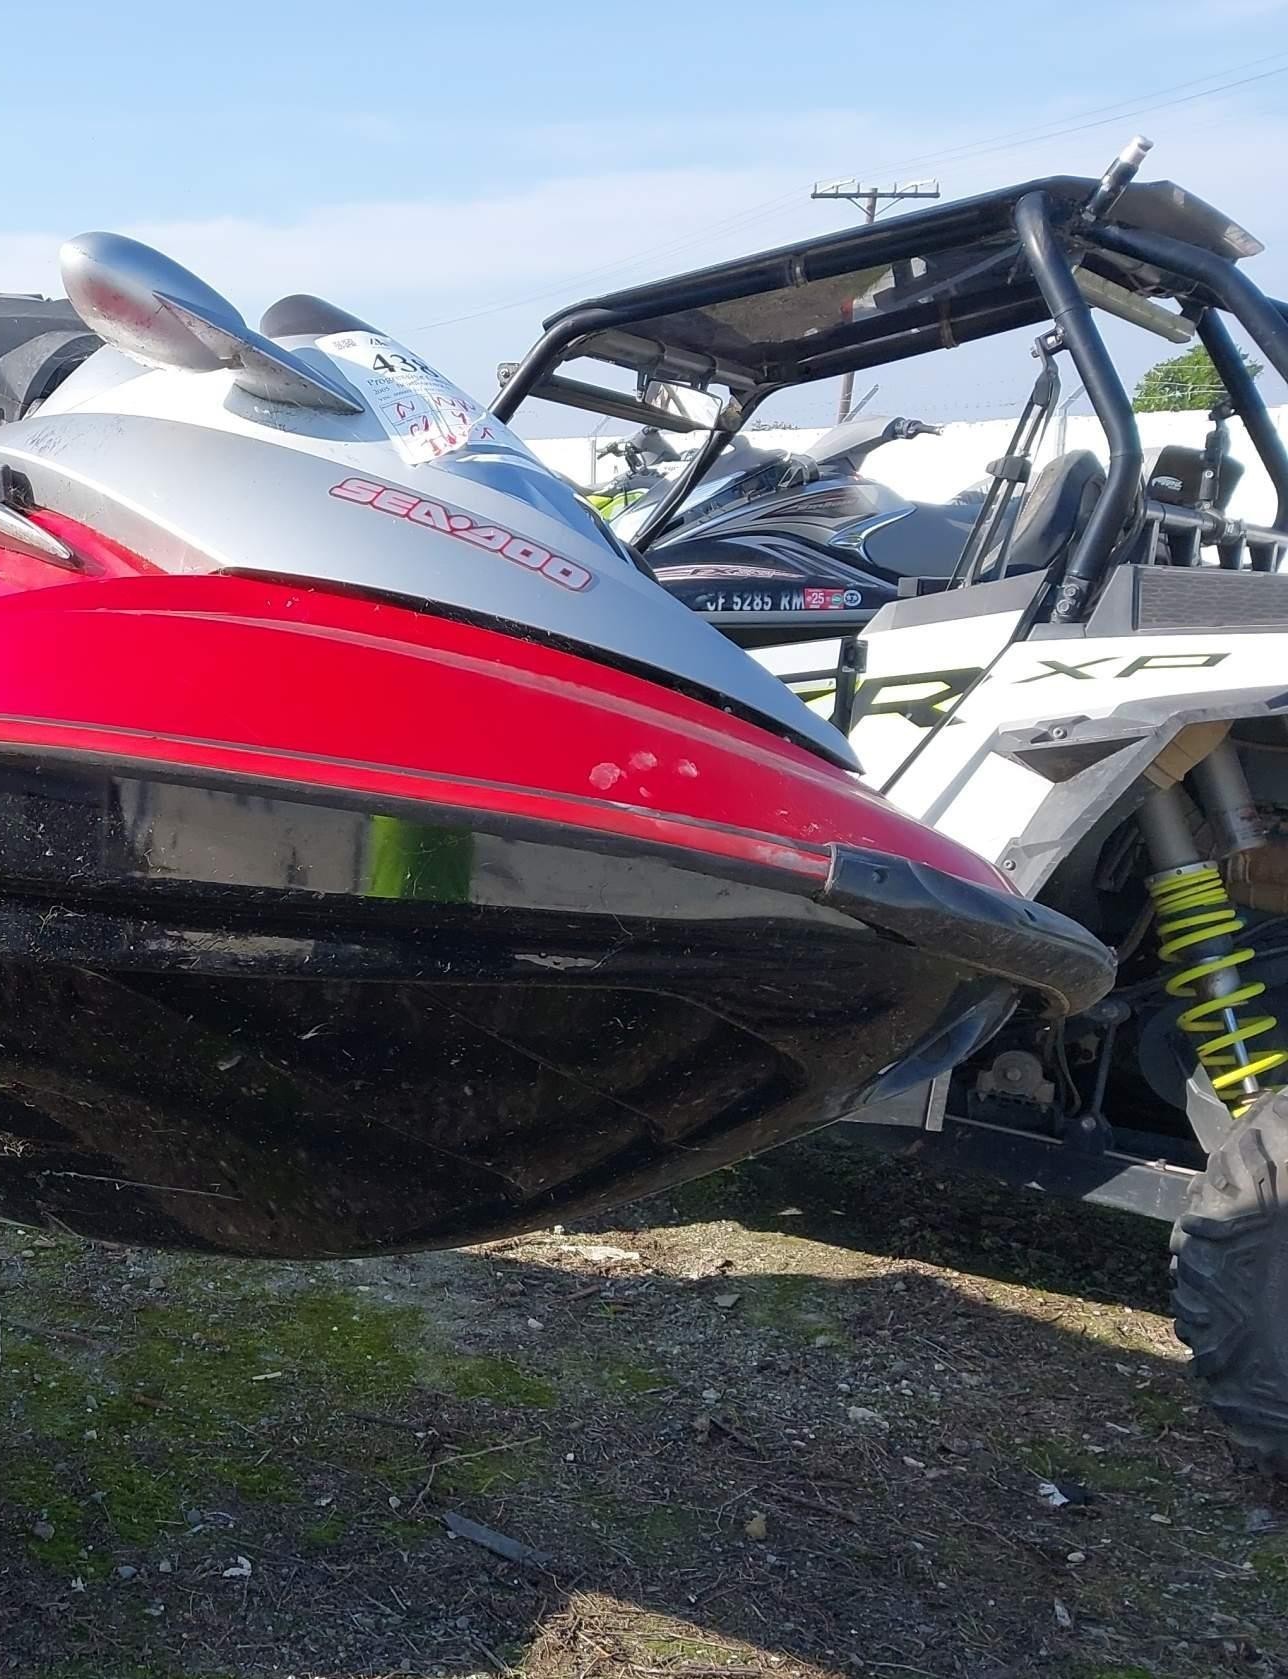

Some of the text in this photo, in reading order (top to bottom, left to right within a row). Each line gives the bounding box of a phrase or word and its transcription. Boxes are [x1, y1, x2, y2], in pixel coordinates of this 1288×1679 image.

[732, 591, 772, 611] 5285
[780, 590, 805, 611] RM
[811, 592, 825, 604] 25
[1011, 652, 1232, 685] XP
